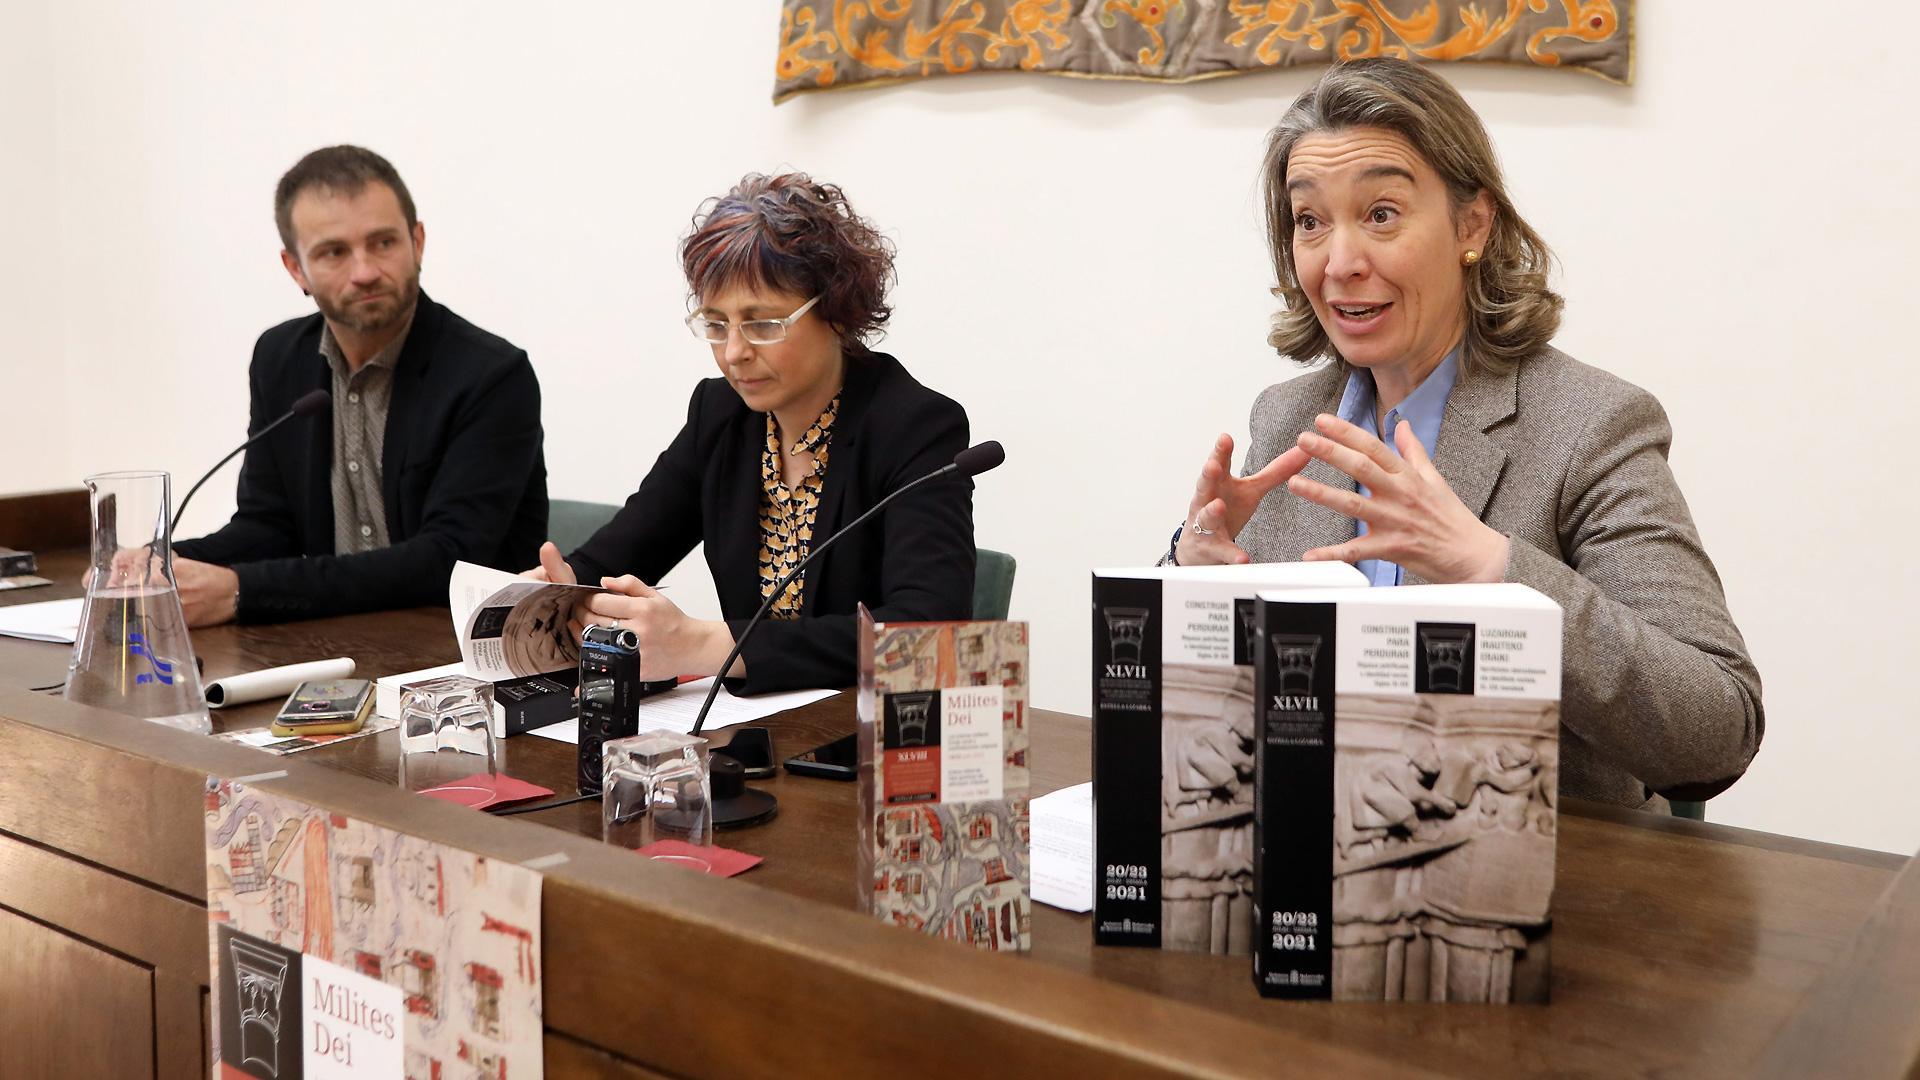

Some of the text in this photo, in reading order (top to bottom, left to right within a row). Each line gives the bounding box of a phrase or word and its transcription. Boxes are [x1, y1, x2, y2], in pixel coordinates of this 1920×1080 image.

[1185, 600, 1230, 610] CONSTRUIR
[1208, 613, 1229, 622] PARA
[1187, 624, 1229, 633] PERDURAR
[1361, 624, 1410, 634] CONSTRUIR
[1386, 637, 1409, 646] PARA
[589, 652, 608, 661] TASCAM
[1105, 664, 1146, 679] XLVII
[947, 693, 999, 710] Milites
[1273, 695, 1319, 711] XLVII
[947, 711, 972, 727] Dei
[1106, 864, 1148, 879] 20/23
[1106, 884, 1146, 901] 2021
[1272, 911, 1318, 927] 20/23
[1272, 933, 1316, 951] 2021
[312, 976, 395, 1040] Milites
[313, 1019, 352, 1067] Dei
